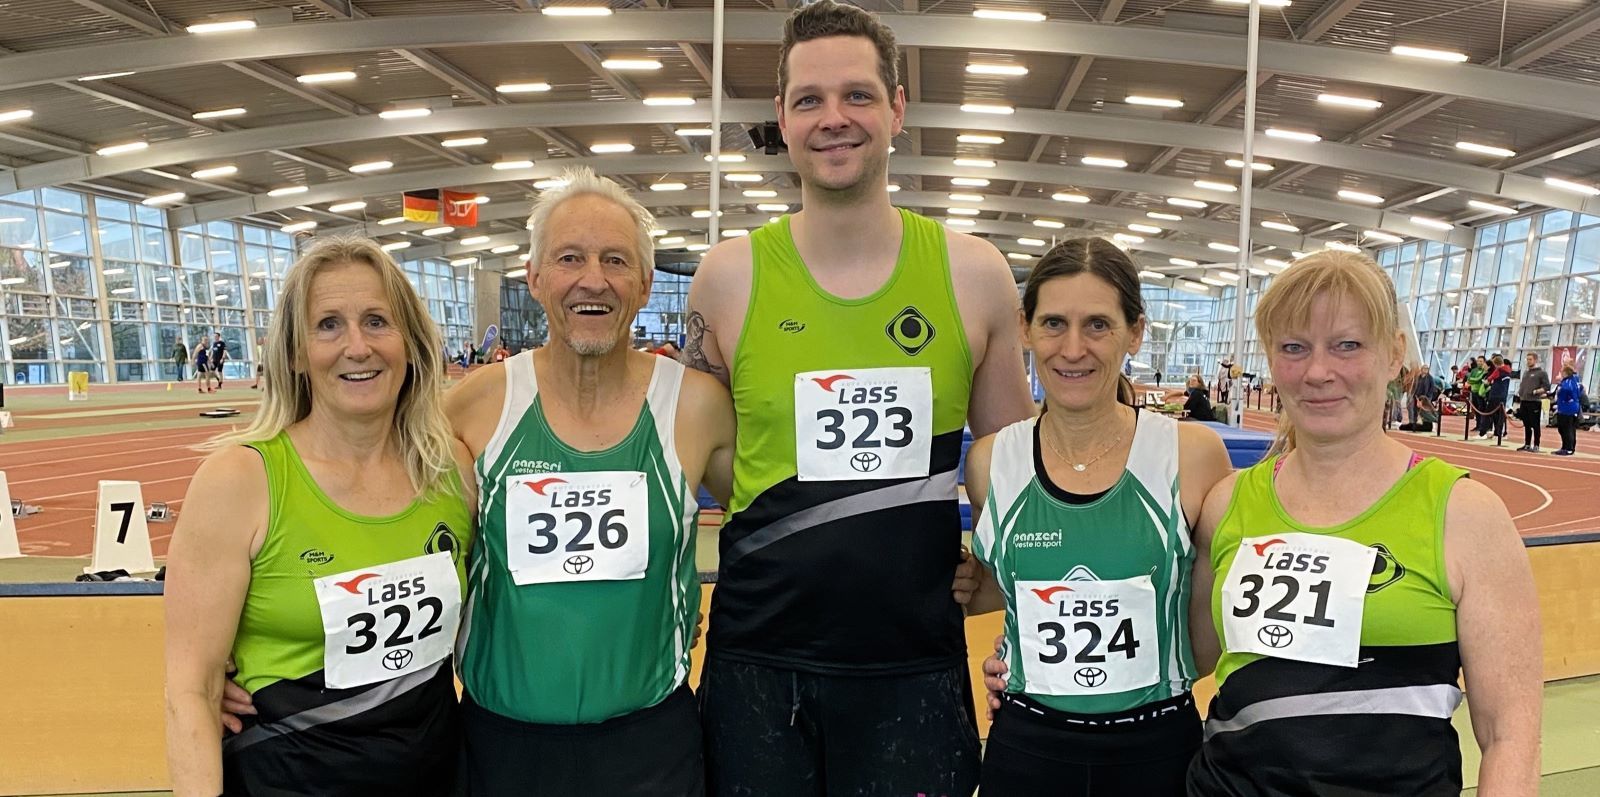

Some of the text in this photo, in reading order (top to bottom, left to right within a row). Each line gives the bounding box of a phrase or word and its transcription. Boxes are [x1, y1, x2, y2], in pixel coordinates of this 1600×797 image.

[838, 386, 898, 405] Lass
[816, 406, 914, 450] 323
[512, 459, 562, 472] panzeri
[550, 489, 612, 508] Lass
[110, 502, 135, 544] 7
[528, 509, 629, 554] 326
[1013, 528, 1062, 544] panzeri
[1042, 541, 1062, 549] sport
[1263, 552, 1330, 573] Lass
[368, 576, 426, 606] Lass
[1232, 574, 1335, 628] 321
[1058, 599, 1120, 617] Lass
[345, 596, 443, 654] 322
[1037, 617, 1140, 664] 324
